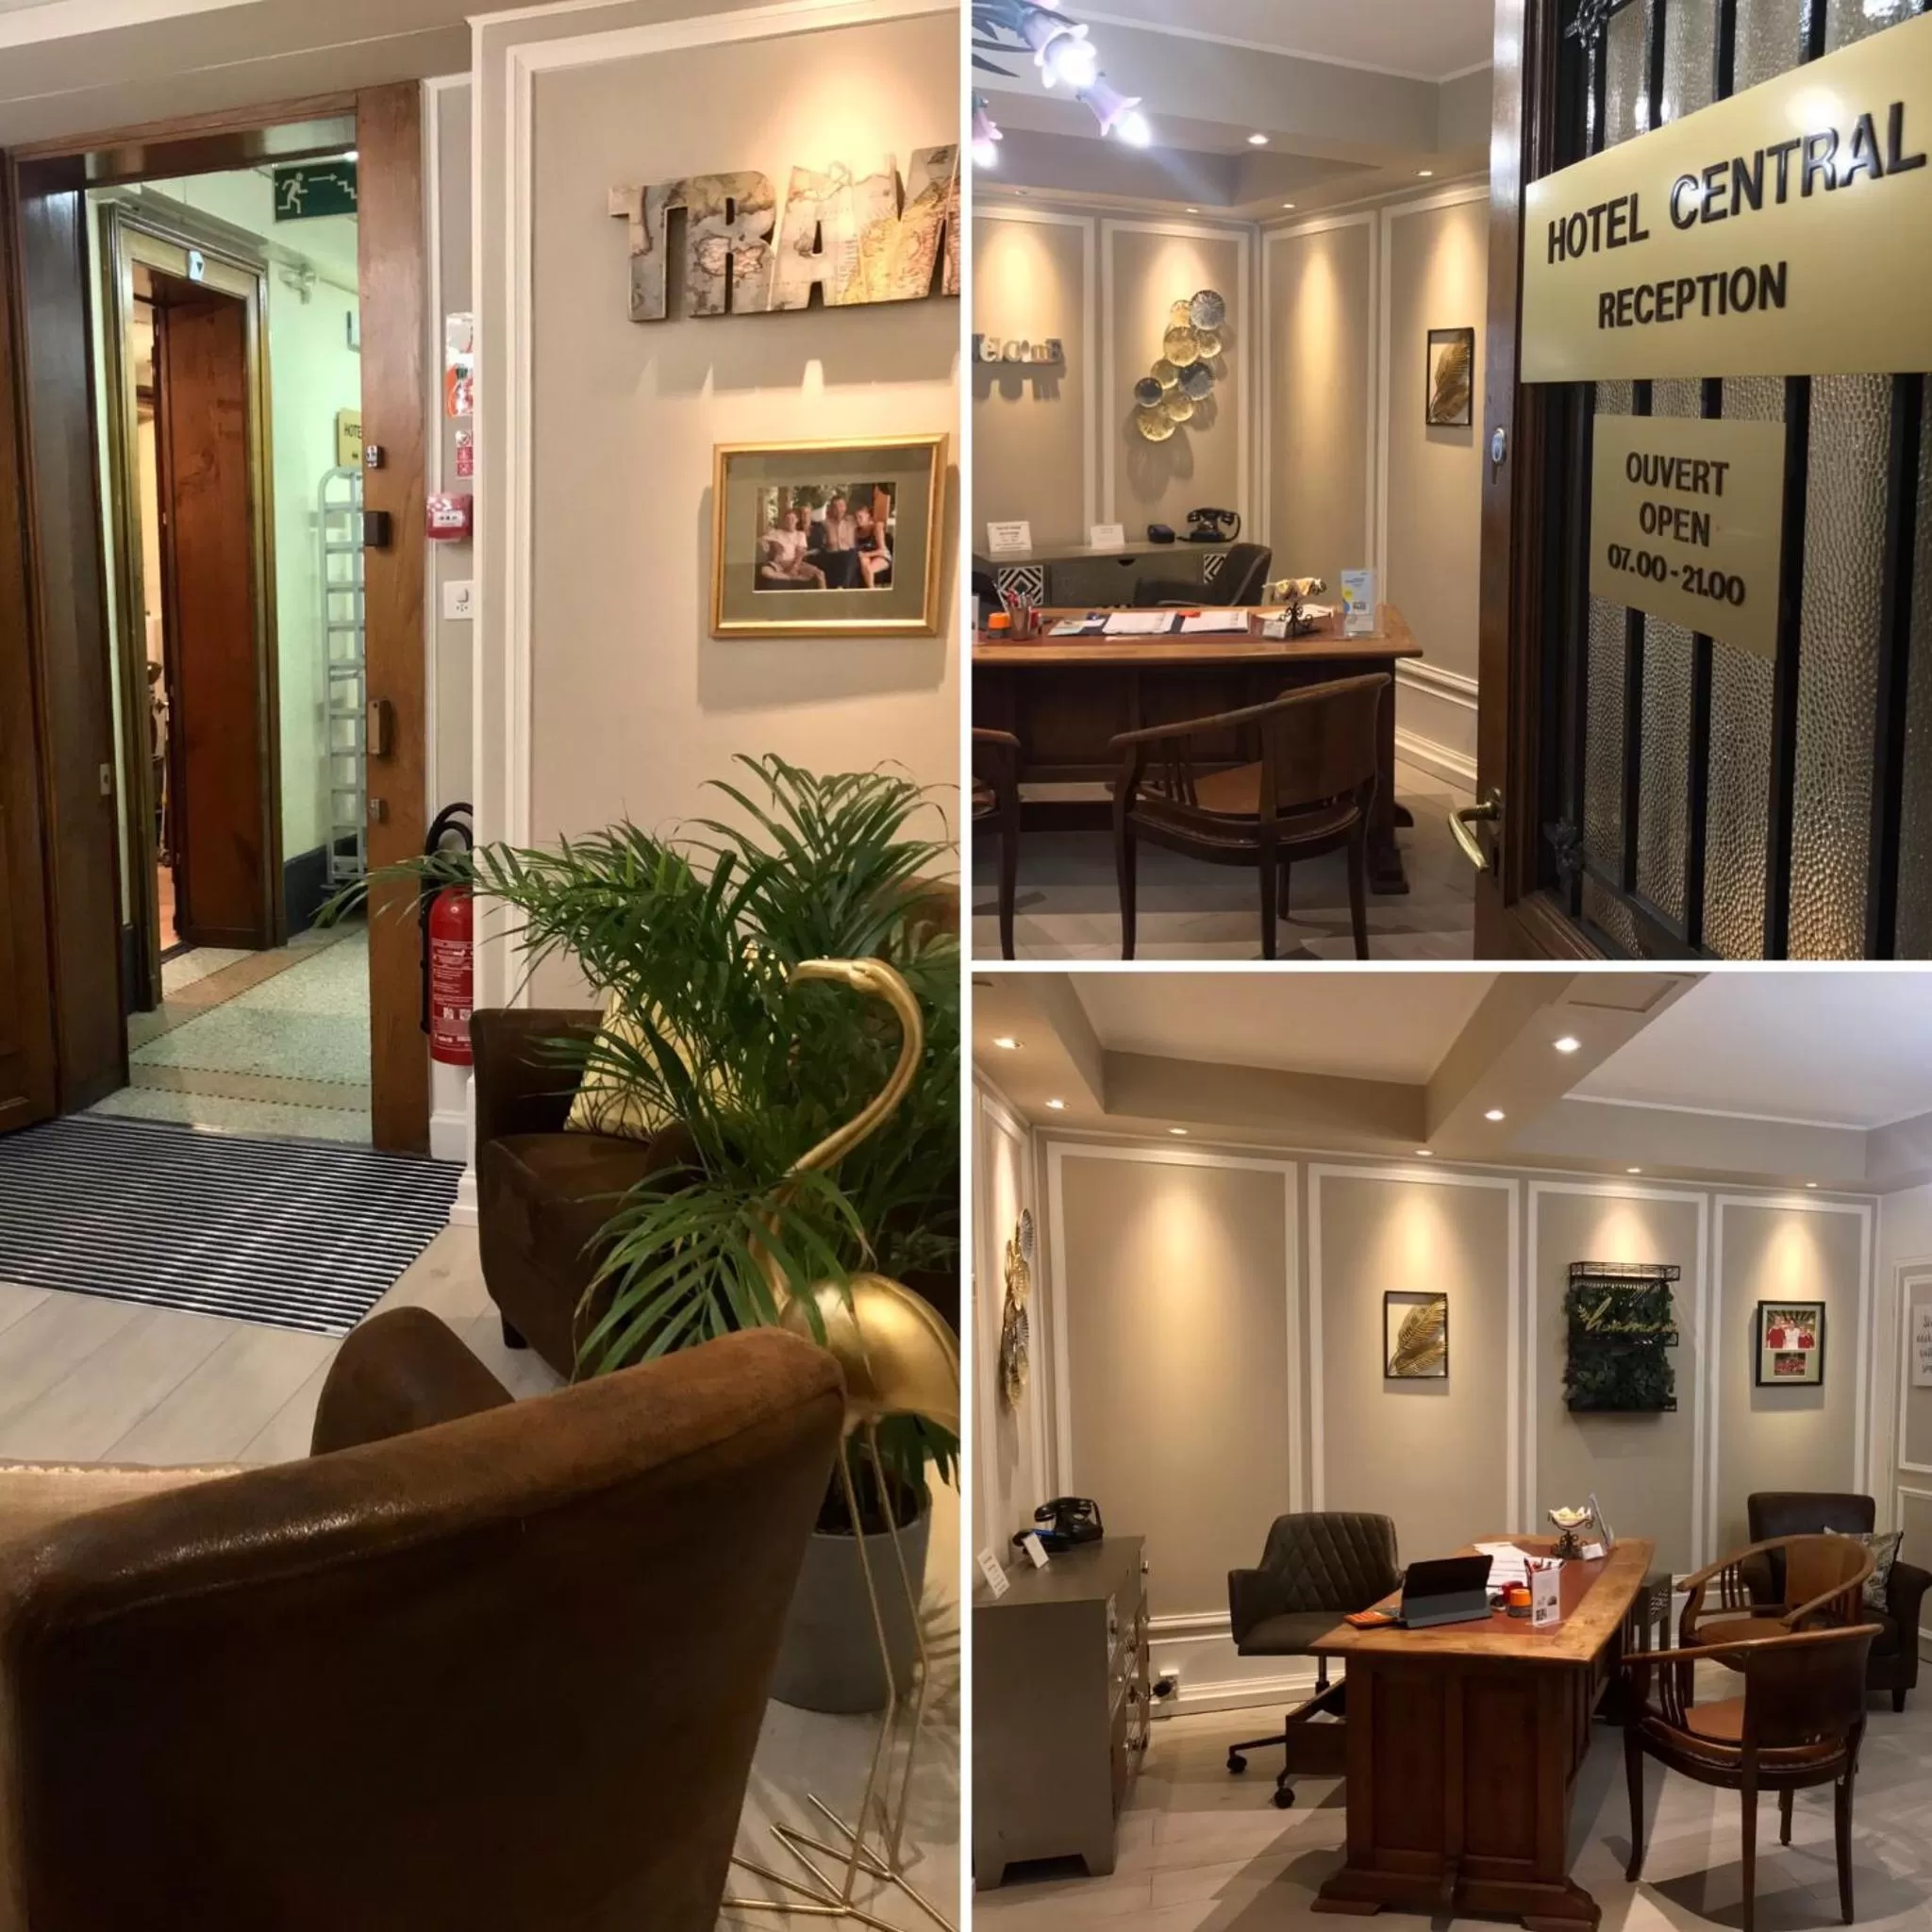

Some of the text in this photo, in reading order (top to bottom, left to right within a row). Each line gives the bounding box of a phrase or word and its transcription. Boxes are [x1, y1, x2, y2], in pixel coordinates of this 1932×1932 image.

[1548, 102, 1926, 264] HOTEL CENTRAL
[608, 142, 959, 323] TRAV
[1598, 261, 1788, 328] RECEPTION
[1625, 451, 1729, 497] OUVERT
[1640, 502, 1710, 547] OPEN
